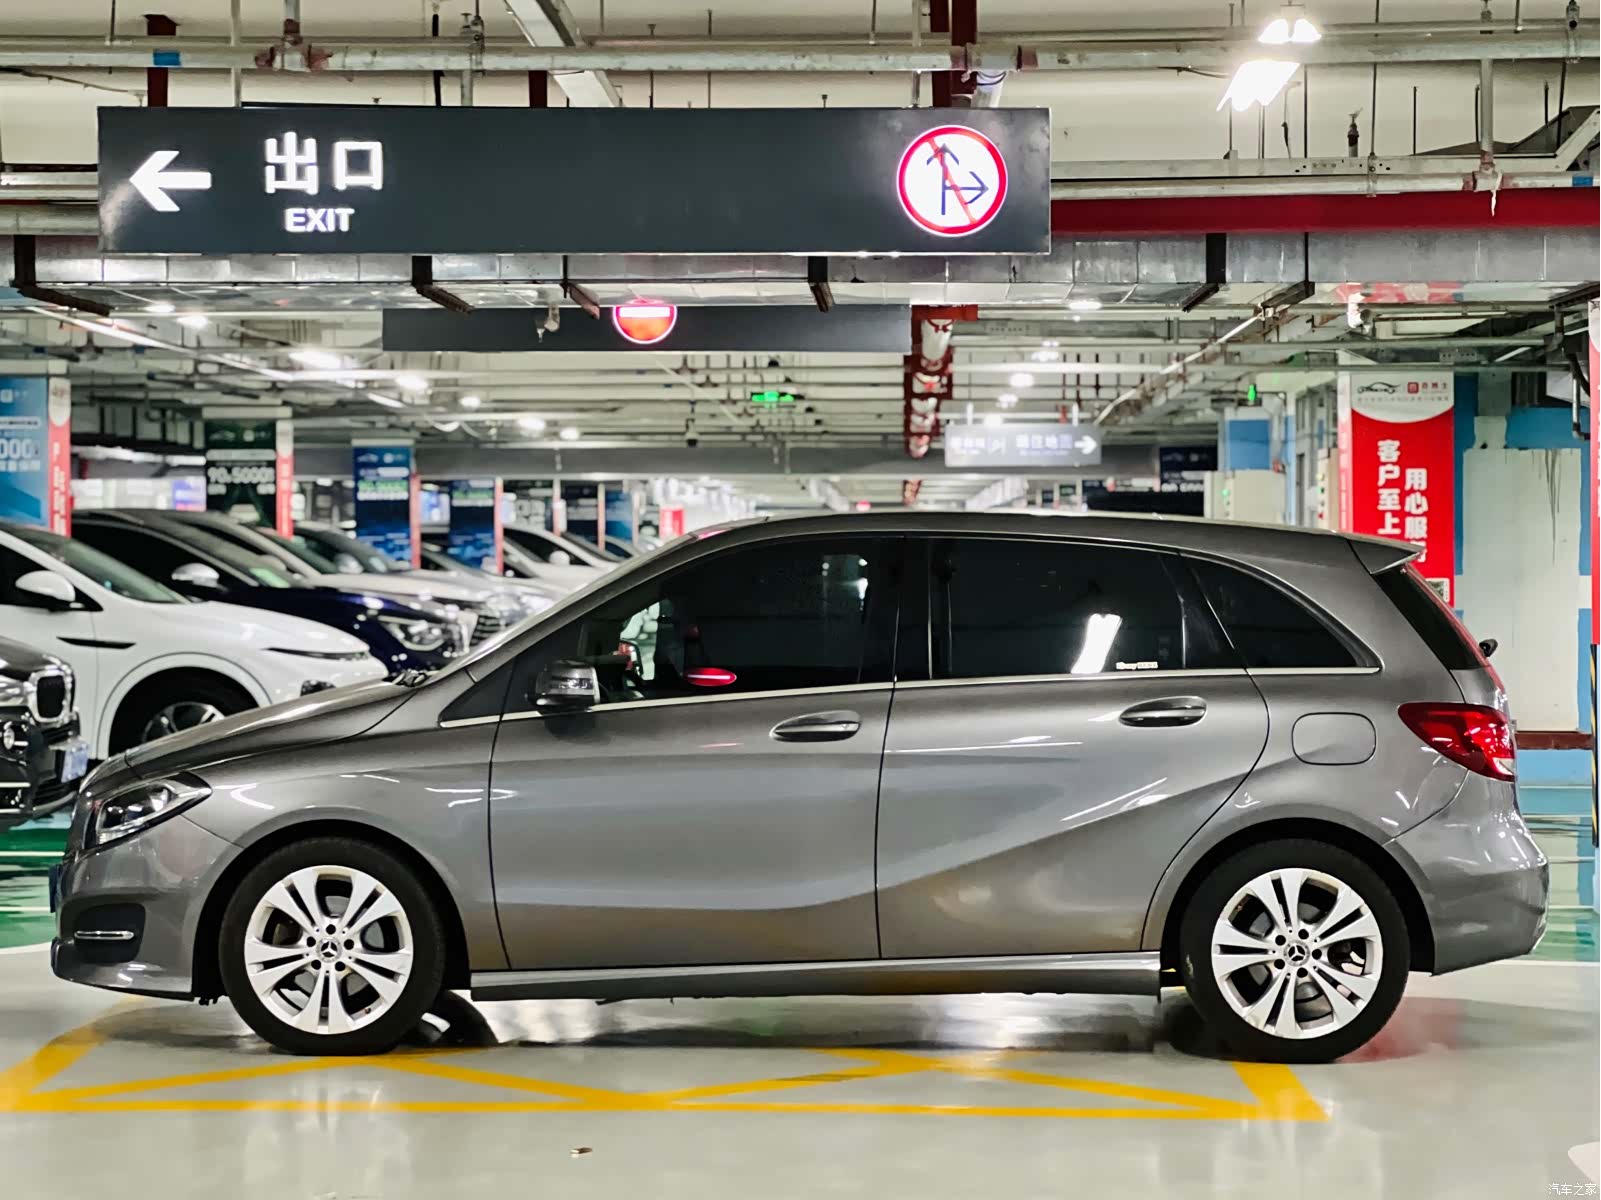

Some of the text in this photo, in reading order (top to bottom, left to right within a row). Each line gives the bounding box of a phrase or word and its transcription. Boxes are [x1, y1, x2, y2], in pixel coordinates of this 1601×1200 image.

[265, 131, 384, 195] 出口
[285, 207, 355, 233] EXIT
[1377, 439, 1401, 535] 客户至上
